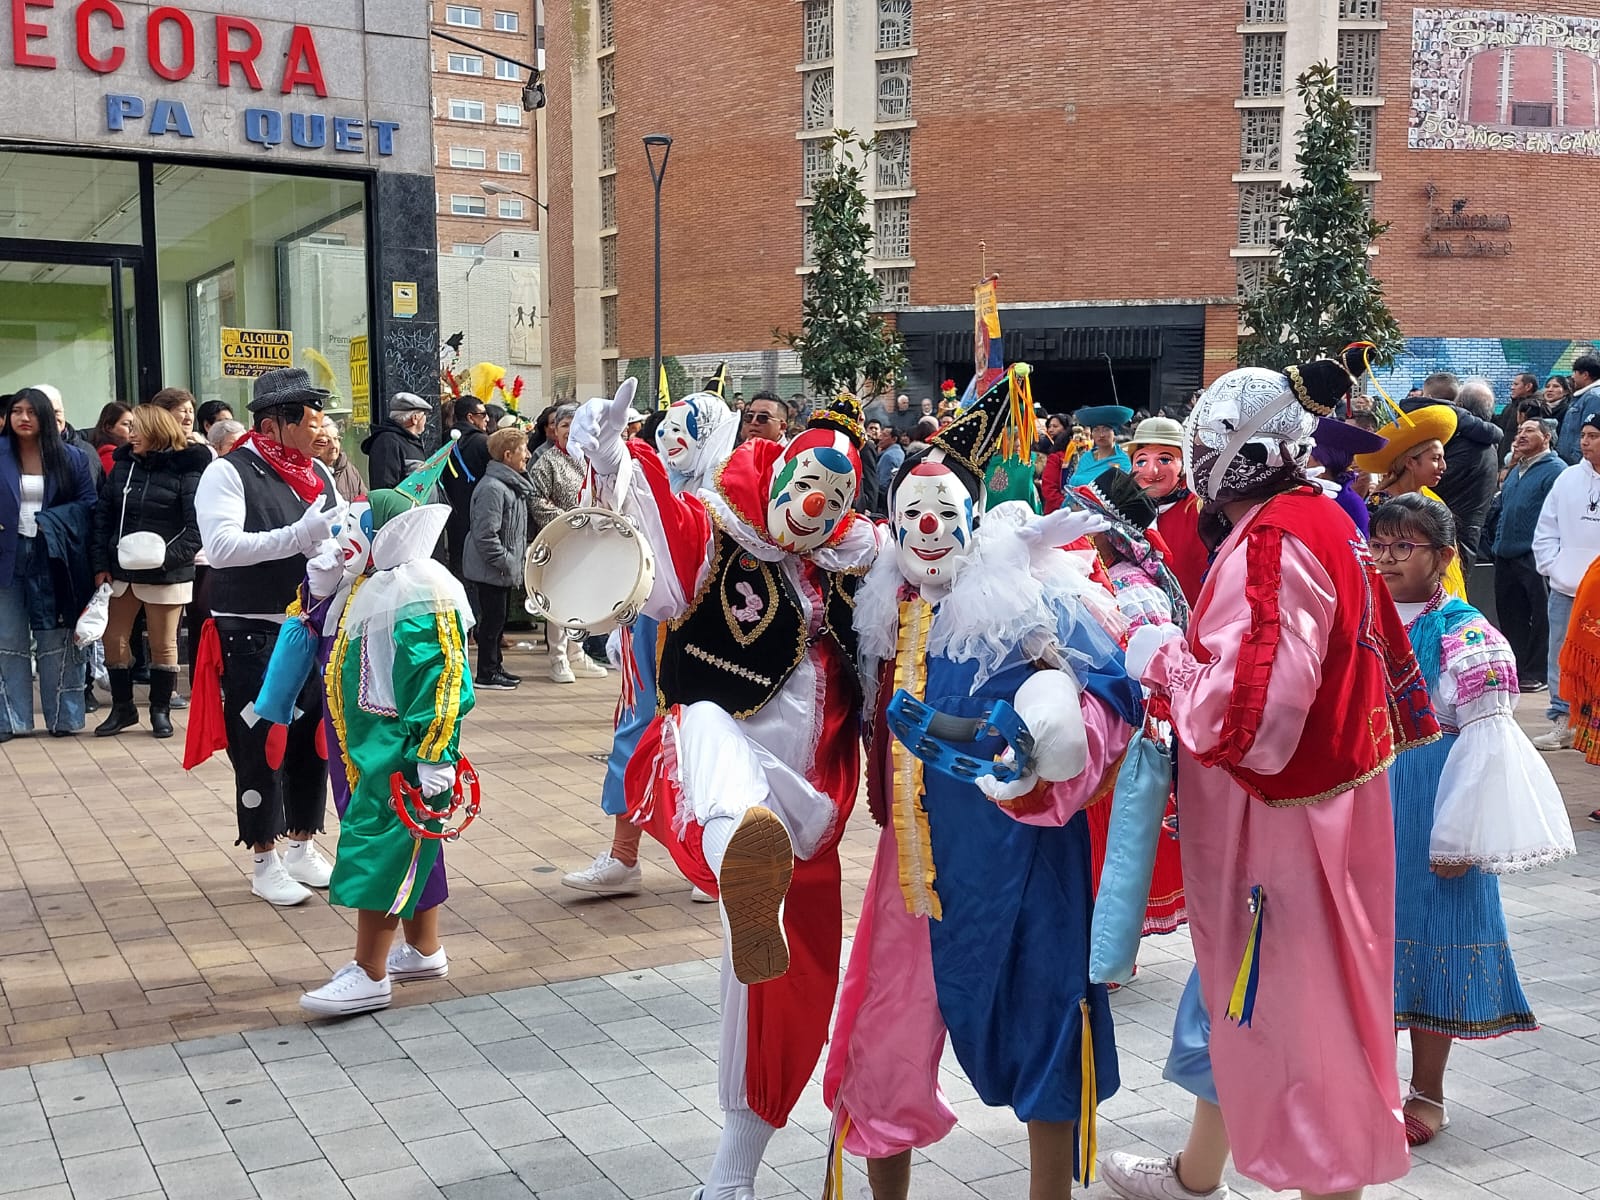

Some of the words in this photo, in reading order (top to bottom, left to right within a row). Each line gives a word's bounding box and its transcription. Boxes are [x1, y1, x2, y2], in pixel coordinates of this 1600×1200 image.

[1422, 112, 1458, 138] 50
[1465, 124, 1516, 148] AÑOS
[1526, 136, 1549, 153] EN
[242, 333, 288, 345] ALQUILA
[224, 344, 290, 360] CASTILLO
